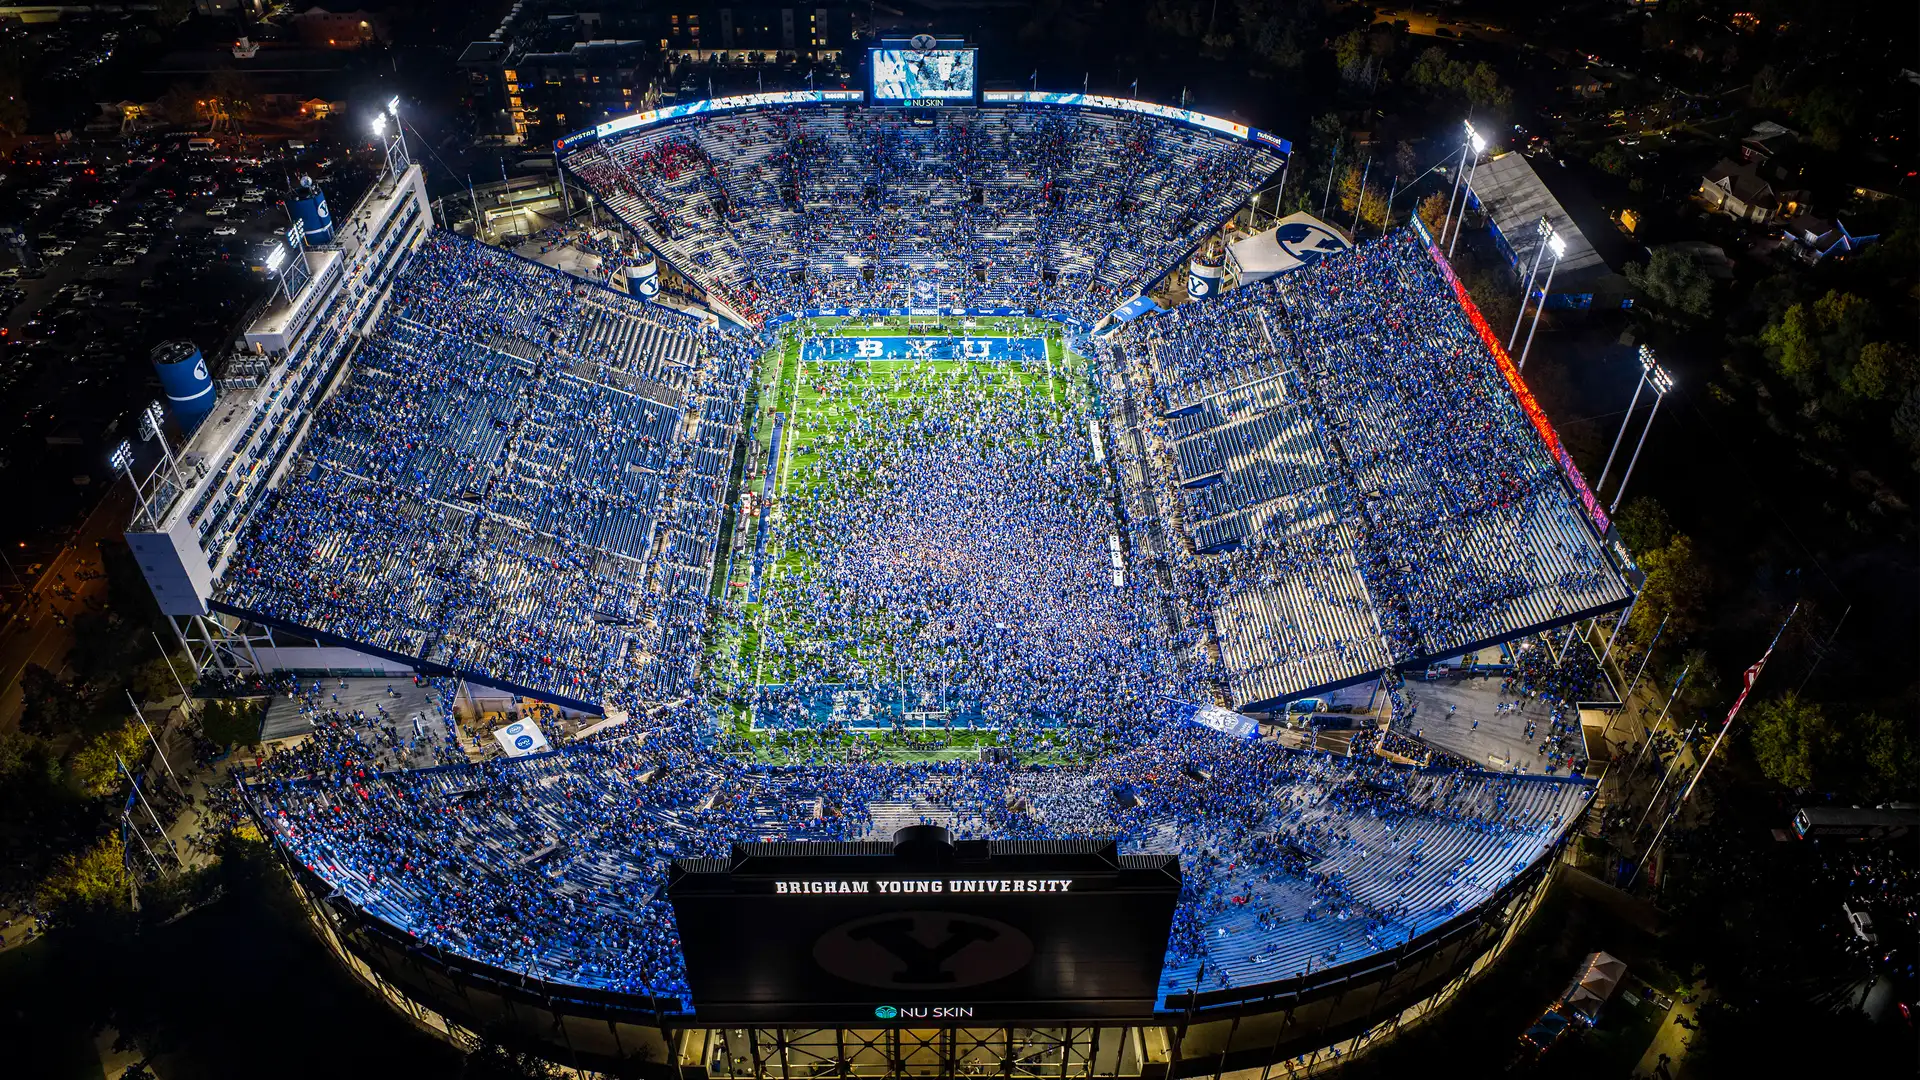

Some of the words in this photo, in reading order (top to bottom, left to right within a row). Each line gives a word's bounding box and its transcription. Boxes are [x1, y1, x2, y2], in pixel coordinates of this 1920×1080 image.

[563, 129, 596, 145] WAYSTAR
[1257, 131, 1282, 146] nutricost
[1614, 540, 1632, 569] qualtrics
[775, 881, 869, 894] BRIGHAM
[876, 880, 943, 893] YOUNG
[949, 879, 1073, 893] UNIVERSITY
[900, 1007, 928, 1018] NU
[932, 1006, 974, 1018] SKIN
